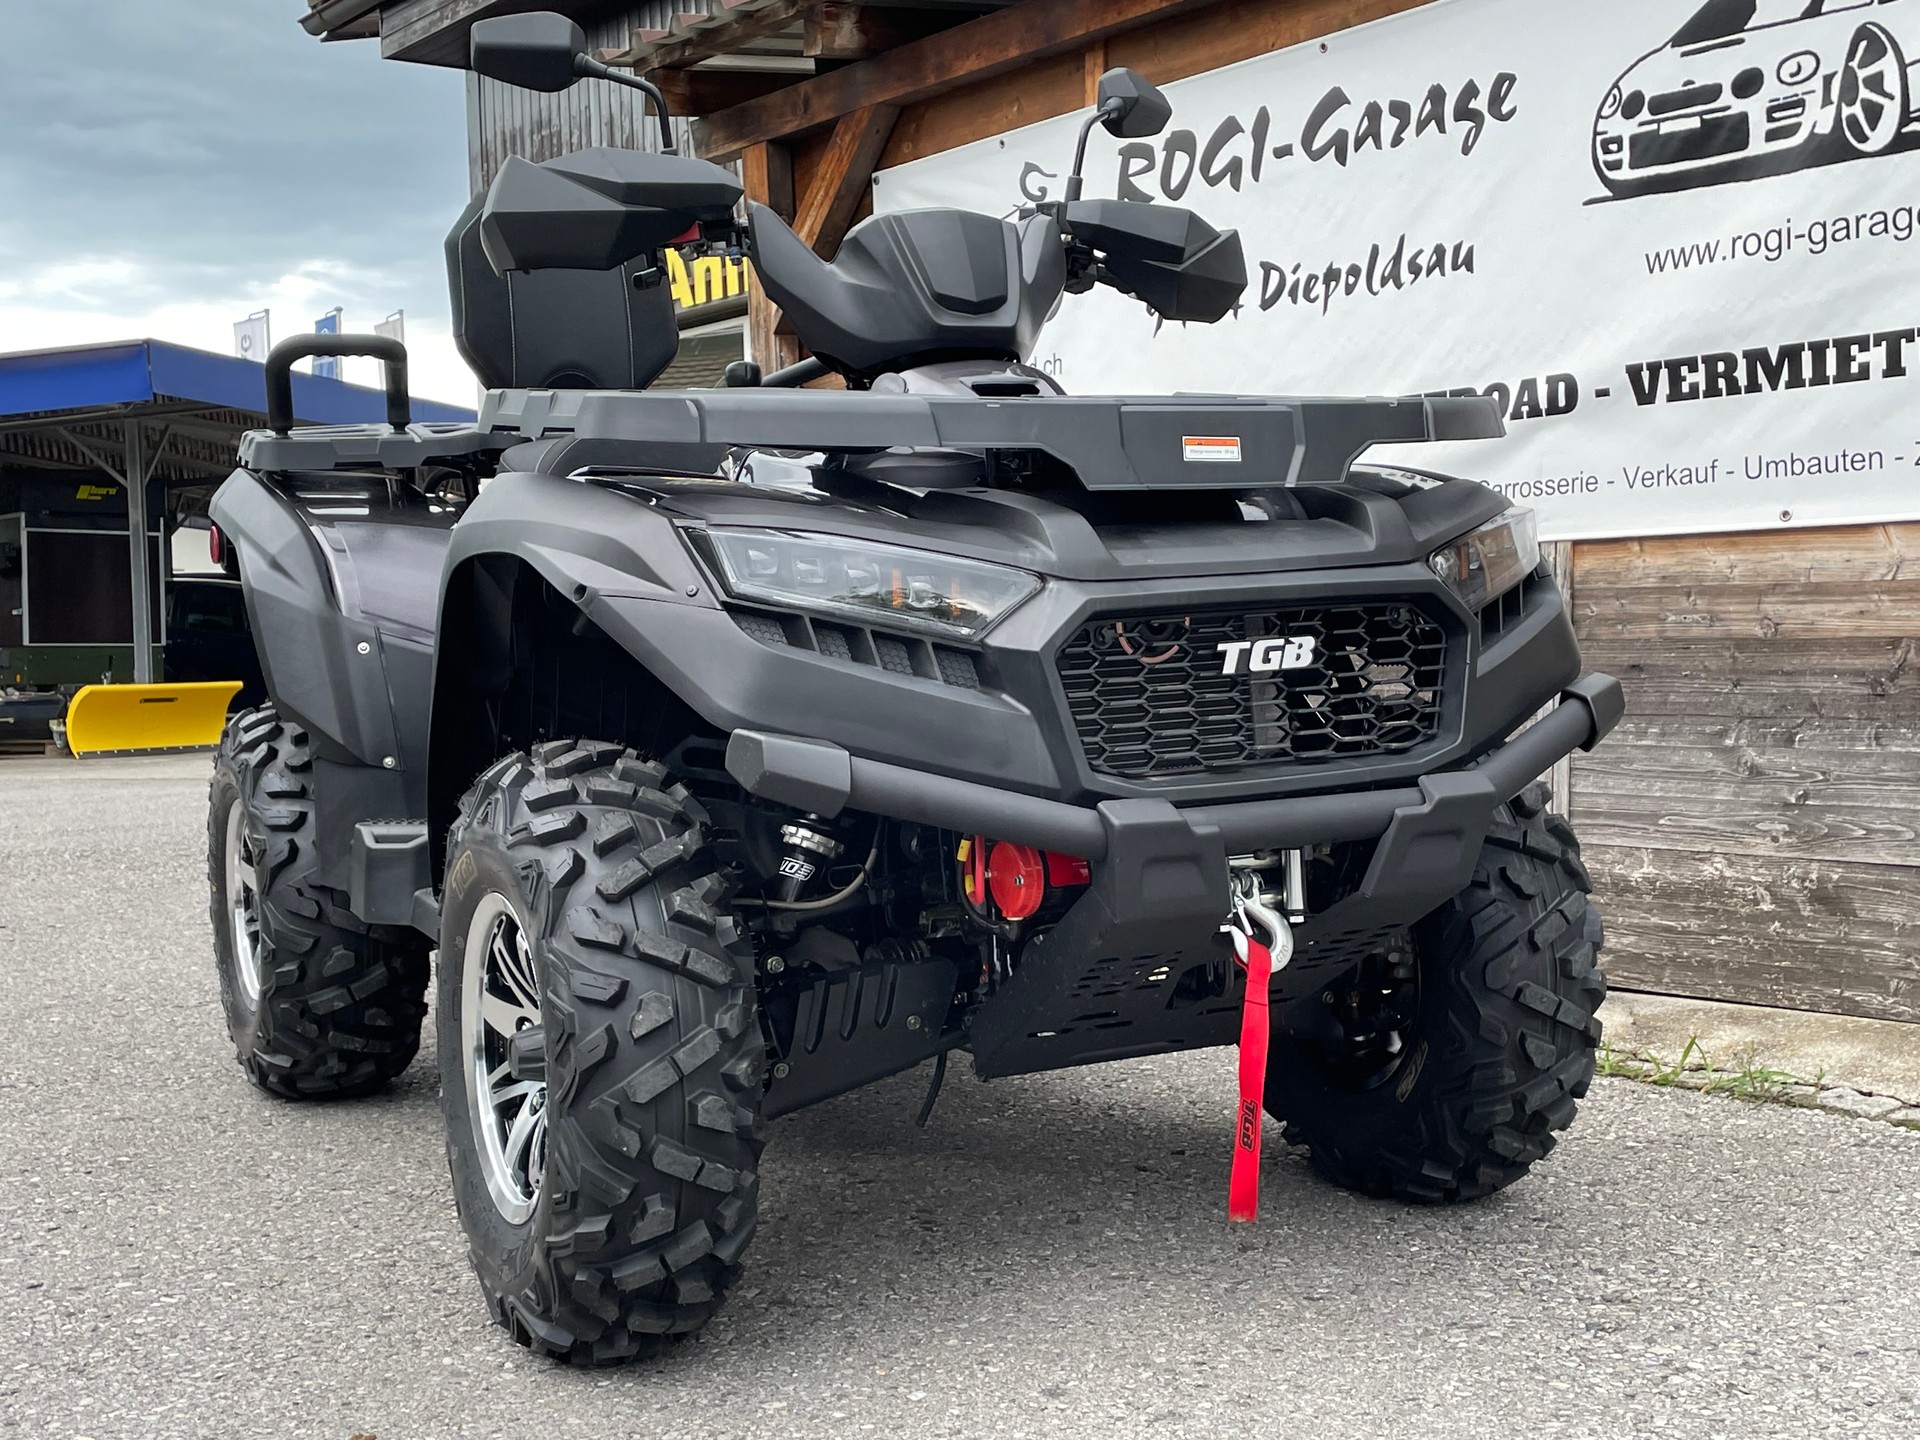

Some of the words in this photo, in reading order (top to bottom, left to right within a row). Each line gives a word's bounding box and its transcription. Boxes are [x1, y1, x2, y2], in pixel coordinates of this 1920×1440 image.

[1117, 72, 1517, 204] ROGI-Garage
[1645, 206, 1920, 274] www.rogi-garag
[1259, 233, 1475, 317] Diepoldsau
[1625, 327, 1920, 406] VERMIET
[1623, 459, 1719, 489] Verkauf
[1744, 449, 1883, 480] Umbauten
[1217, 636, 1316, 675] TGB
[1240, 1099, 1258, 1152] TGB
